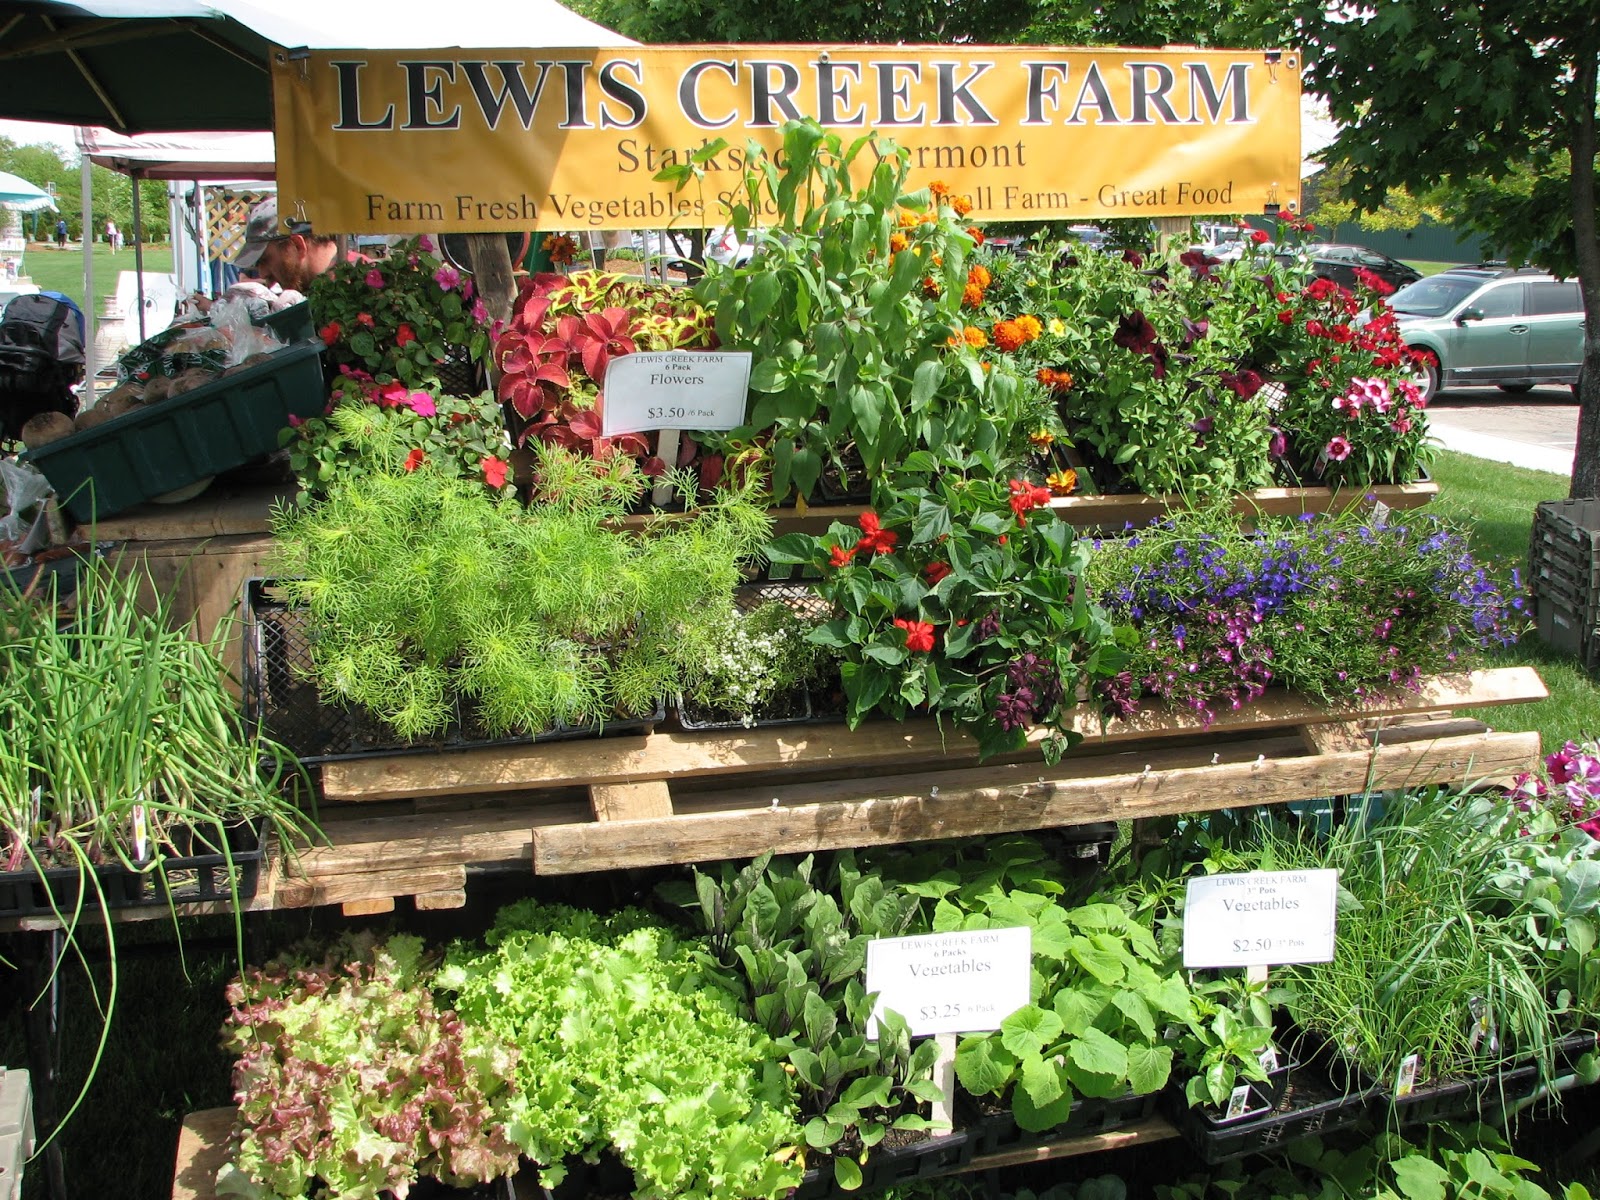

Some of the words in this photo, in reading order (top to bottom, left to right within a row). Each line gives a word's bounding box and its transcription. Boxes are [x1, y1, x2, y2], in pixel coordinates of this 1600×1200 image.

[329, 59, 648, 131] LEWIS
[678, 59, 1000, 131] CREEK
[1020, 60, 1257, 127] FARM
[366, 194, 444, 221] Farm
[456, 192, 538, 220] Fresh
[547, 191, 705, 226] Vegetables
[1003, 186, 1072, 210] Farm
[1097, 183, 1166, 207] Great
[1175, 181, 1233, 206] Food
[635, 355, 663, 364] LEWIS
[665, 355, 695, 364] CREEK
[697, 356, 723, 364] FARM
[650, 373, 704, 385] Flowers
[647, 407, 685, 419] $3.50
[697, 409, 715, 417] Pack
[1216, 877, 1245, 887] LEWIS
[1259, 885, 1276, 894] Pots
[1222, 897, 1300, 912] Vegetables
[901, 938, 933, 950] LEWIS
[970, 934, 999, 945] FARM
[1232, 937, 1272, 953] $2.50
[942, 949, 967, 958] Packs
[908, 959, 992, 977] Vegetables
[919, 1003, 962, 1021] $3.25
